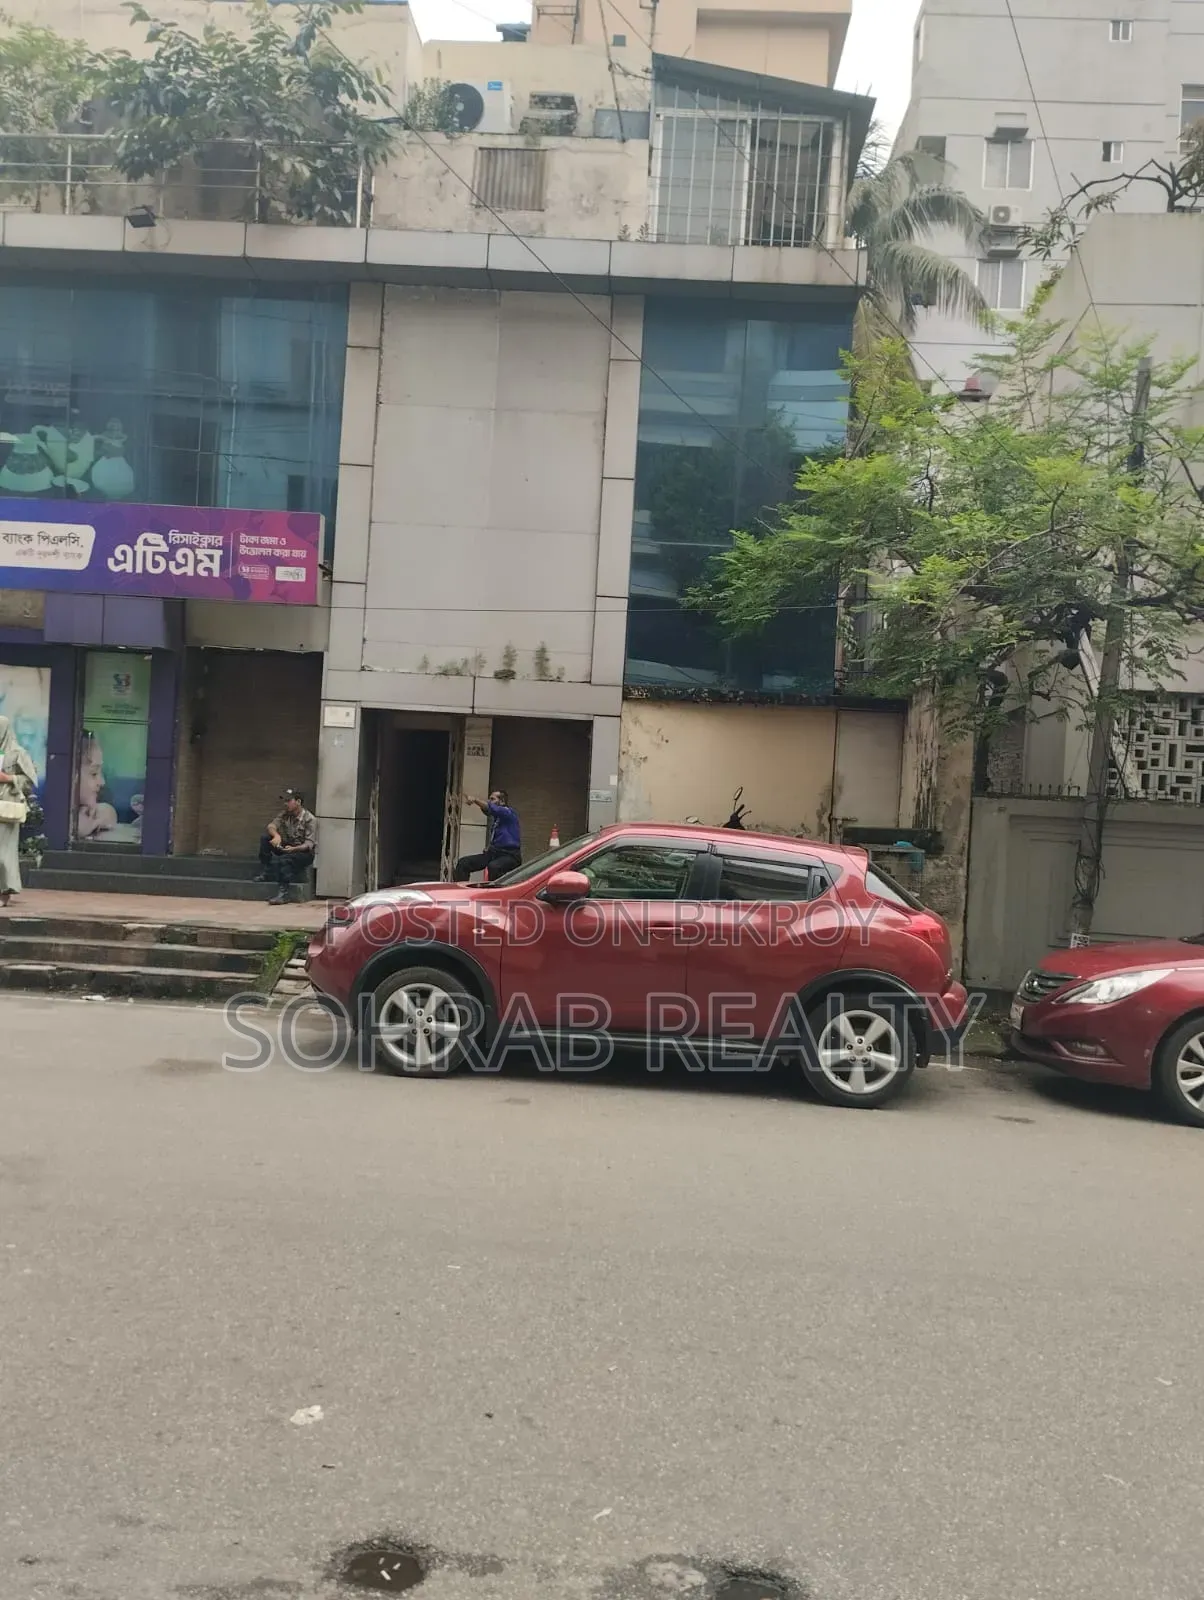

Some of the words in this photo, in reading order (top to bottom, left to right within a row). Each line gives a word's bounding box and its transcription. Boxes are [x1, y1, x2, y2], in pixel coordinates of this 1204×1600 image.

[1, 532, 34, 545] ব্যাংক
[168, 529, 224, 548] রিসাইক্লার
[240, 533, 259, 544] টাকা
[107, 532, 223, 577] এটিএম
